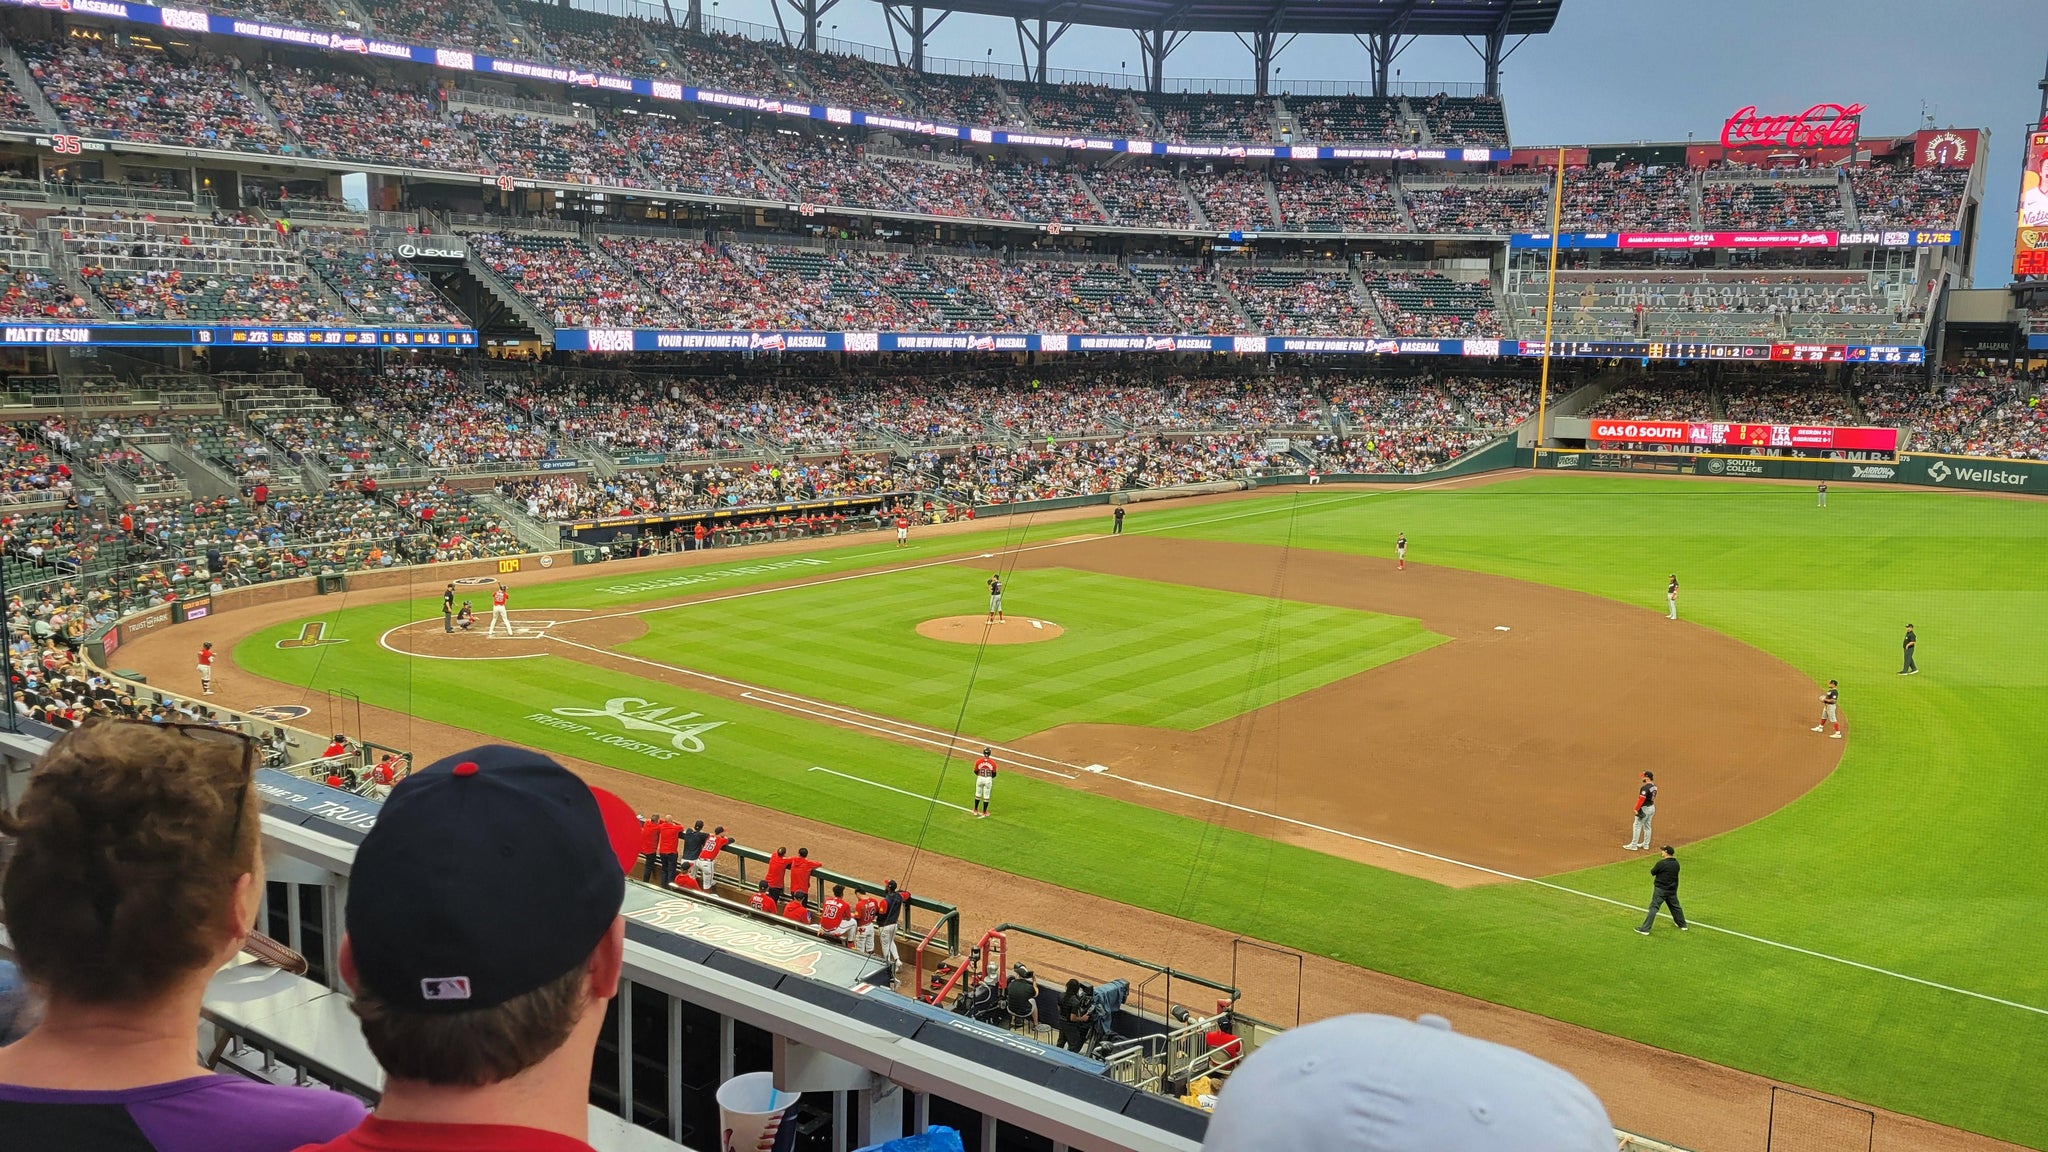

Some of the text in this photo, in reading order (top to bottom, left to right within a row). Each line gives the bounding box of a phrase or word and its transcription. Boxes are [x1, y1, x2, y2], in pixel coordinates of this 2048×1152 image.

[73, 0, 128, 17] BASEBALL
[234, 22, 411, 58] YOUR NEW HOME FOR Braves BASEBALL
[493, 61, 632, 90] YOUR NEW HOME FOR Braves BASEBALL
[1720, 103, 1867, 149] Coca-Cola
[53, 134, 80, 154] 35
[497, 175, 514, 191] 41
[800, 203, 814, 216] 44
[1862, 233, 1880, 244] PM
[1917, 232, 1951, 244] $7,756
[417, 248, 464, 258] LEXUS
[1615, 287, 1866, 307] HANK AARON TERRACE
[6, 328, 90, 342] MATT OLSON
[428, 333, 439, 344] 42
[462, 333, 472, 344] 14
[589, 330, 633, 340] BRAVES
[658, 333, 826, 349] YOUR NEW HOME FOR Braves BASEBALL
[844, 333, 878, 342] BRAVES
[589, 340, 633, 350] VISION
[844, 341, 878, 351] VISION
[897, 335, 1026, 350] YOUR NEW HOME FOR Braves BASEBALL
[1081, 336, 1211, 350] YOUR NEW HOME FOR Braves BASEBALL
[1285, 340, 1439, 352] YOUR NEW HOME FOR Braves BASEBALL
[1598, 426, 1681, 438] GAS SOUTH
[1691, 429, 1708, 439] AL
[1773, 427, 1790, 435] TEX
[1726, 465, 1763, 473] COLLEGE
[1955, 466, 2028, 485] Wellstar
[153, 613, 168, 624] PARK
[523, 713, 592, 734] FREIGHT
[593, 733, 681, 760] LOGISTICS
[285, 794, 309, 803] TO
[824, 905, 838, 918] 13
[622, 897, 818, 962] Braves
